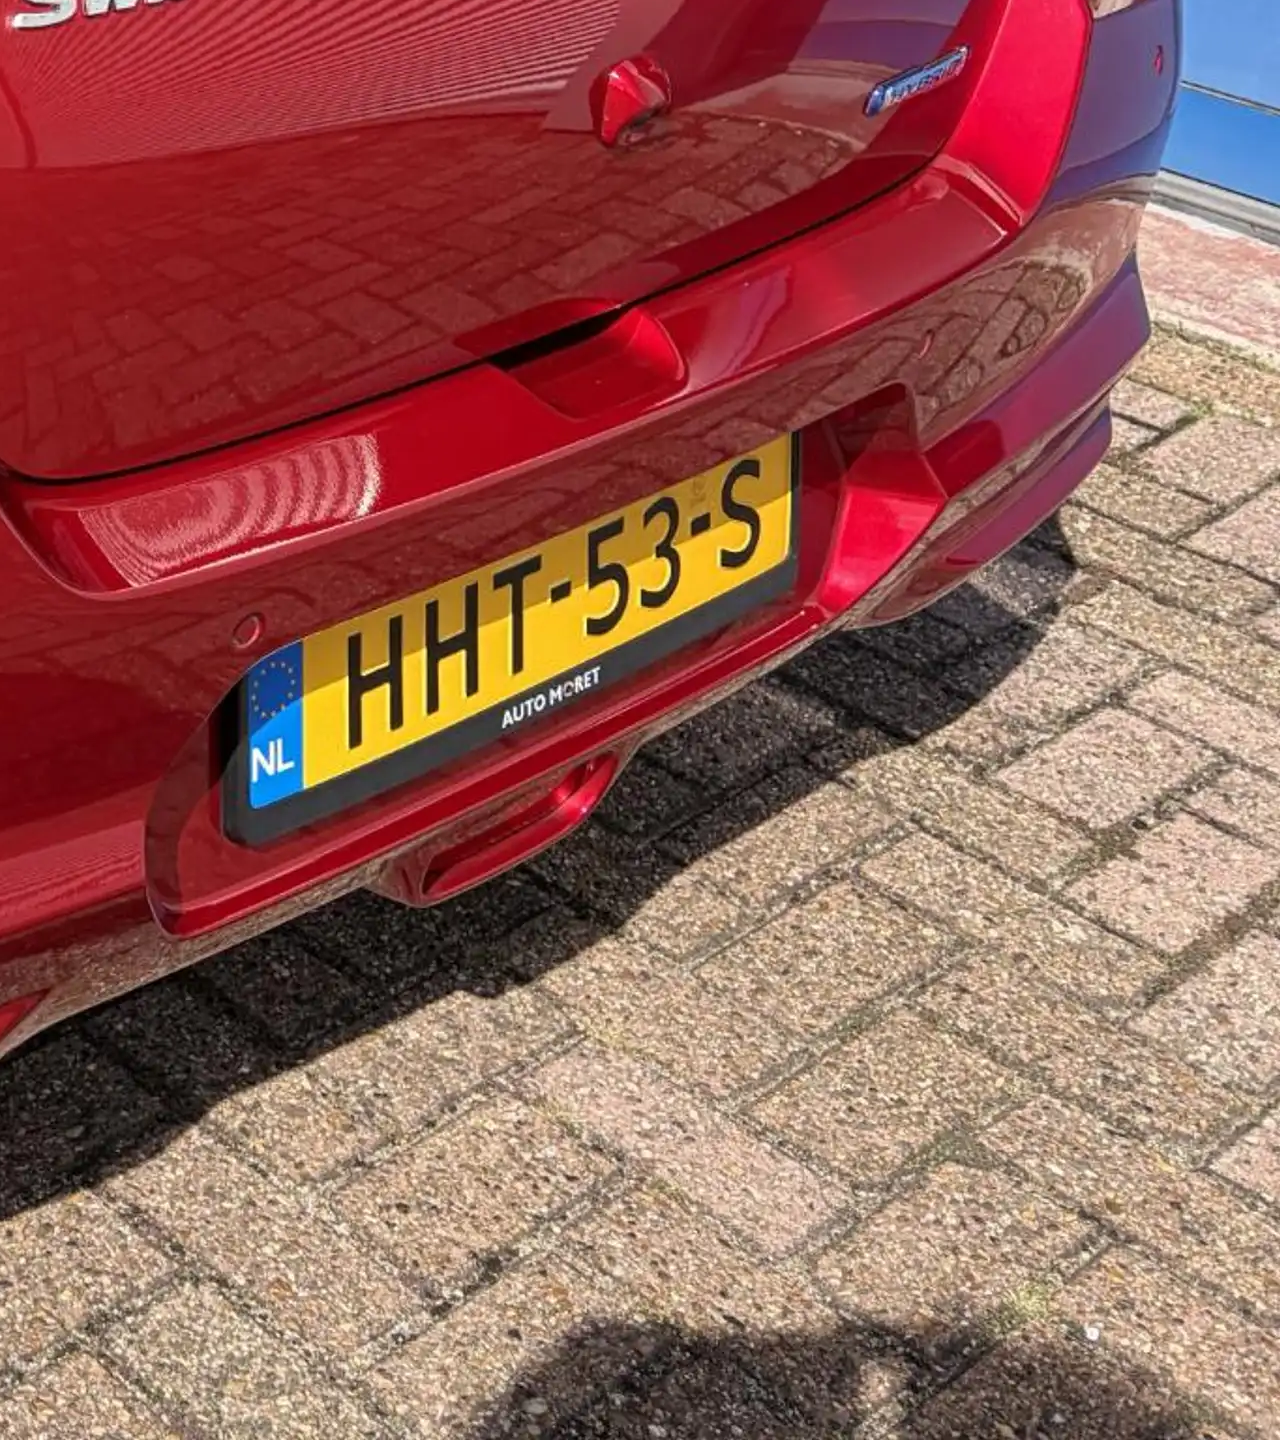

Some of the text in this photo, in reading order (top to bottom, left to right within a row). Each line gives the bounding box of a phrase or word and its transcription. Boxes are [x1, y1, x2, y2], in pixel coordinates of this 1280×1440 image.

[347, 458, 761, 751] HHT-53-S
[501, 665, 601, 729] AUTO MORET
[250, 738, 295, 785] NL
